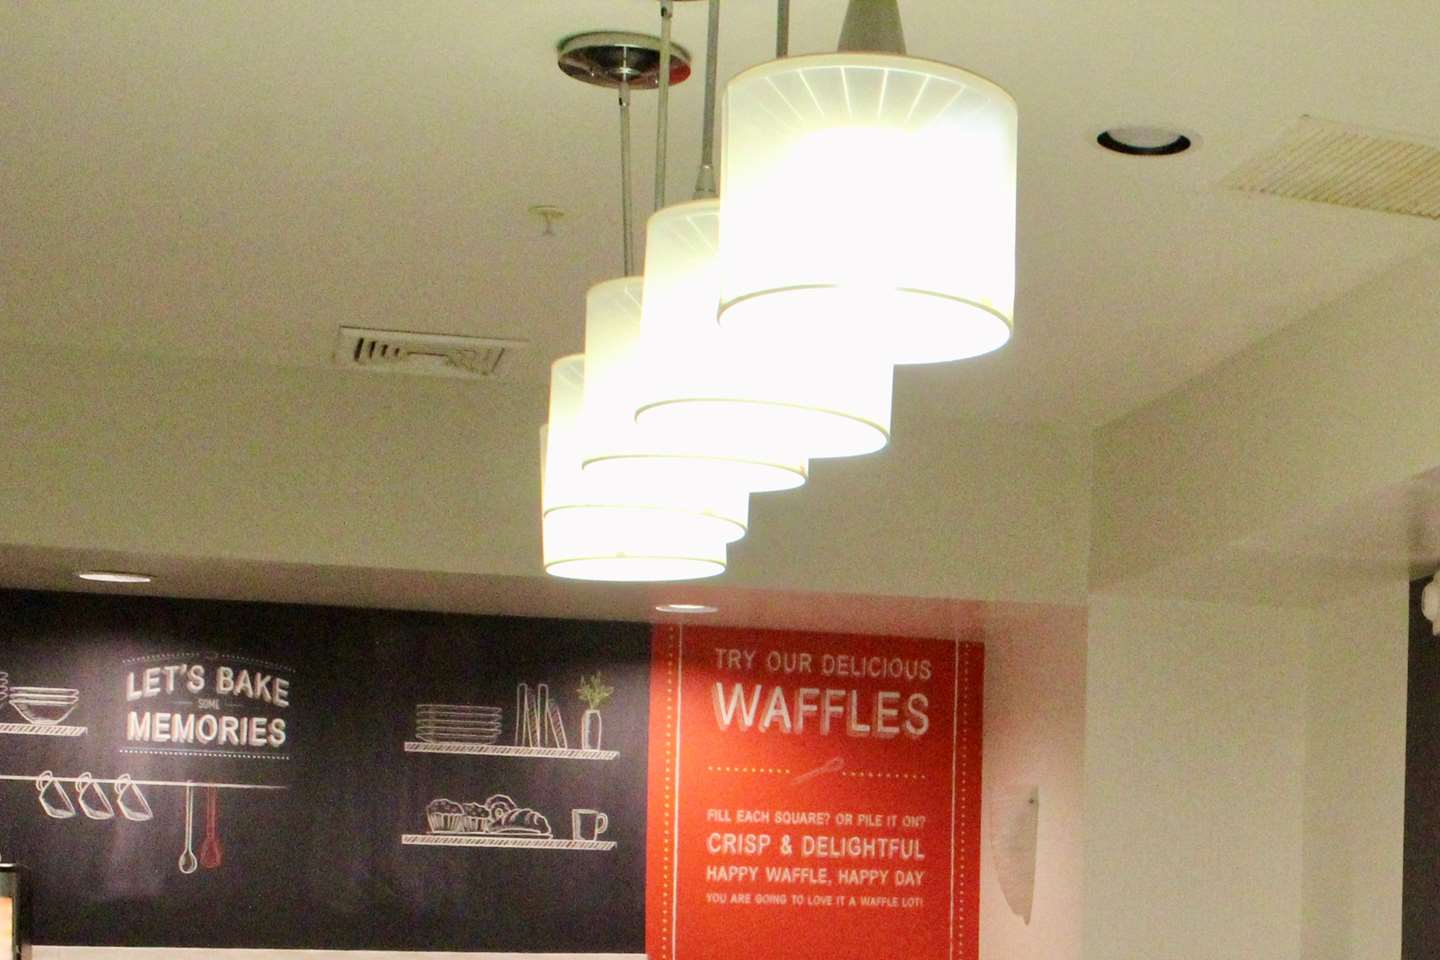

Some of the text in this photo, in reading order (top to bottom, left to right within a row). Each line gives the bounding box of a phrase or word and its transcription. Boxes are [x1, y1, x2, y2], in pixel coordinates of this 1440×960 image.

[715, 648, 932, 680] TRY OUR DELICIOUS
[126, 664, 290, 708] LET'S BAKE
[711, 682, 930, 738] WAFFLES
[126, 711, 287, 747] MEMORIES
[706, 808, 926, 828] FILL EACH SQUARE? OR PILE IT ON?
[706, 832, 925, 859] CRISP & DELIGHTFUL
[706, 865, 758, 882] HAPPY
[838, 869, 888, 886] HAPPY
[895, 870, 926, 886] DAY
[706, 893, 727, 904] YOU
[730, 893, 751, 904] ARE
[755, 894, 787, 905] GOING
[792, 895, 803, 905] TO
[808, 895, 832, 906] LOVE
[837, 896, 845, 906] IT
[848, 896, 856, 906] A
[861, 896, 898, 907] WAFFLE
